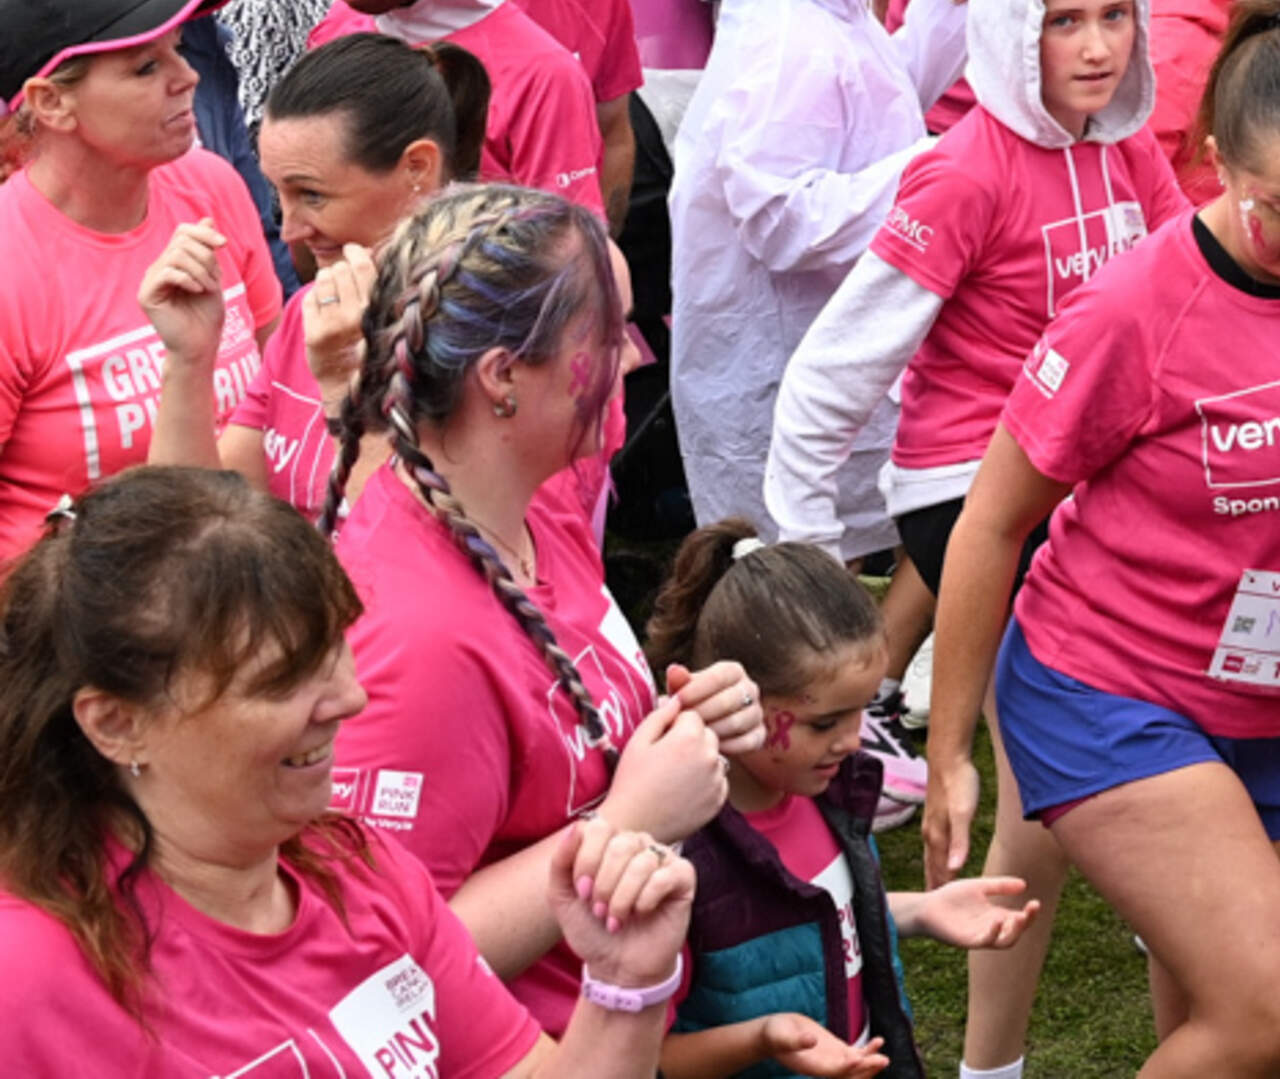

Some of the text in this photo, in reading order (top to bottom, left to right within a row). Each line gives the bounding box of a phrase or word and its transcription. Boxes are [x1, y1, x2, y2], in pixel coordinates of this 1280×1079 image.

[102, 342, 167, 401] GRE
[263, 425, 299, 473] ery
[376, 798, 412, 813] RUN
[379, 786, 416, 800] PINK
[374, 1009, 436, 1079] PIN
